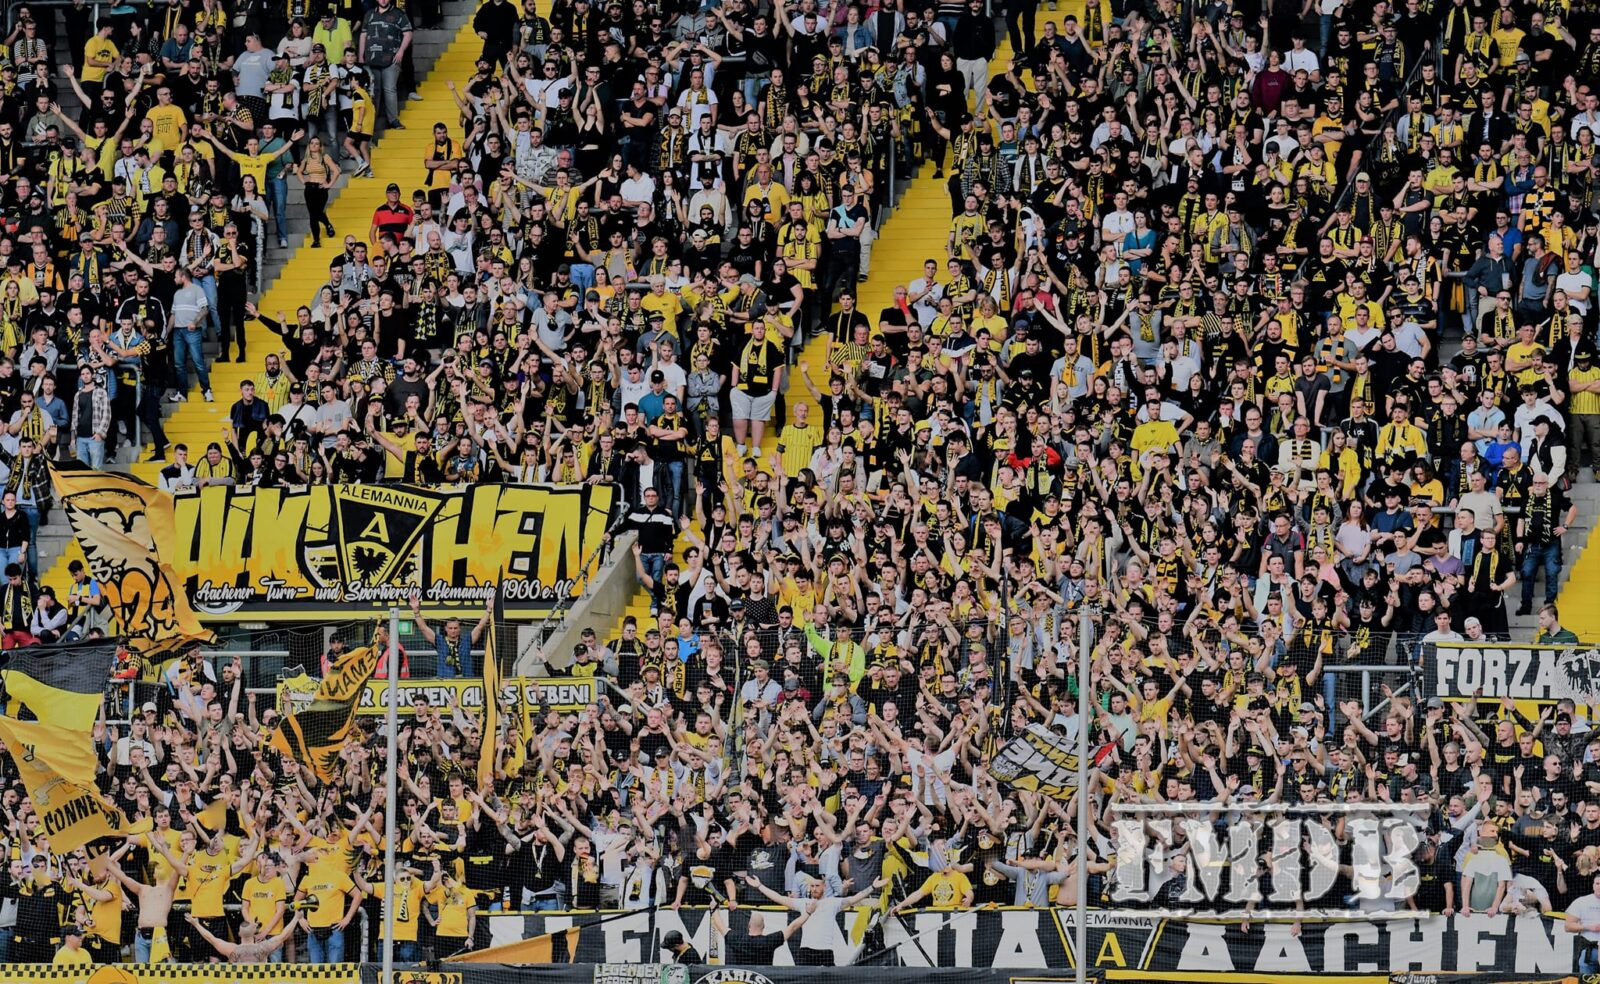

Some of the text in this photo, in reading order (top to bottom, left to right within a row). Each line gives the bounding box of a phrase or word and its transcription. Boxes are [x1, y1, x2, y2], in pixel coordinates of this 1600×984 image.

[340, 484, 429, 513] ALEMANNIA
[360, 511, 390, 543] A
[196, 579, 254, 601] Aachener
[259, 577, 307, 601] Turn-
[315, 579, 342, 601] und
[345, 579, 422, 603] Sportverein
[1437, 648, 1561, 698] FORZA
[462, 685, 519, 707] ALS
[526, 684, 590, 706] GEBEN!
[1065, 911, 1153, 928] AEMANNIA
[1095, 932, 1127, 967] A
[1176, 912, 1575, 973] AACHEN
